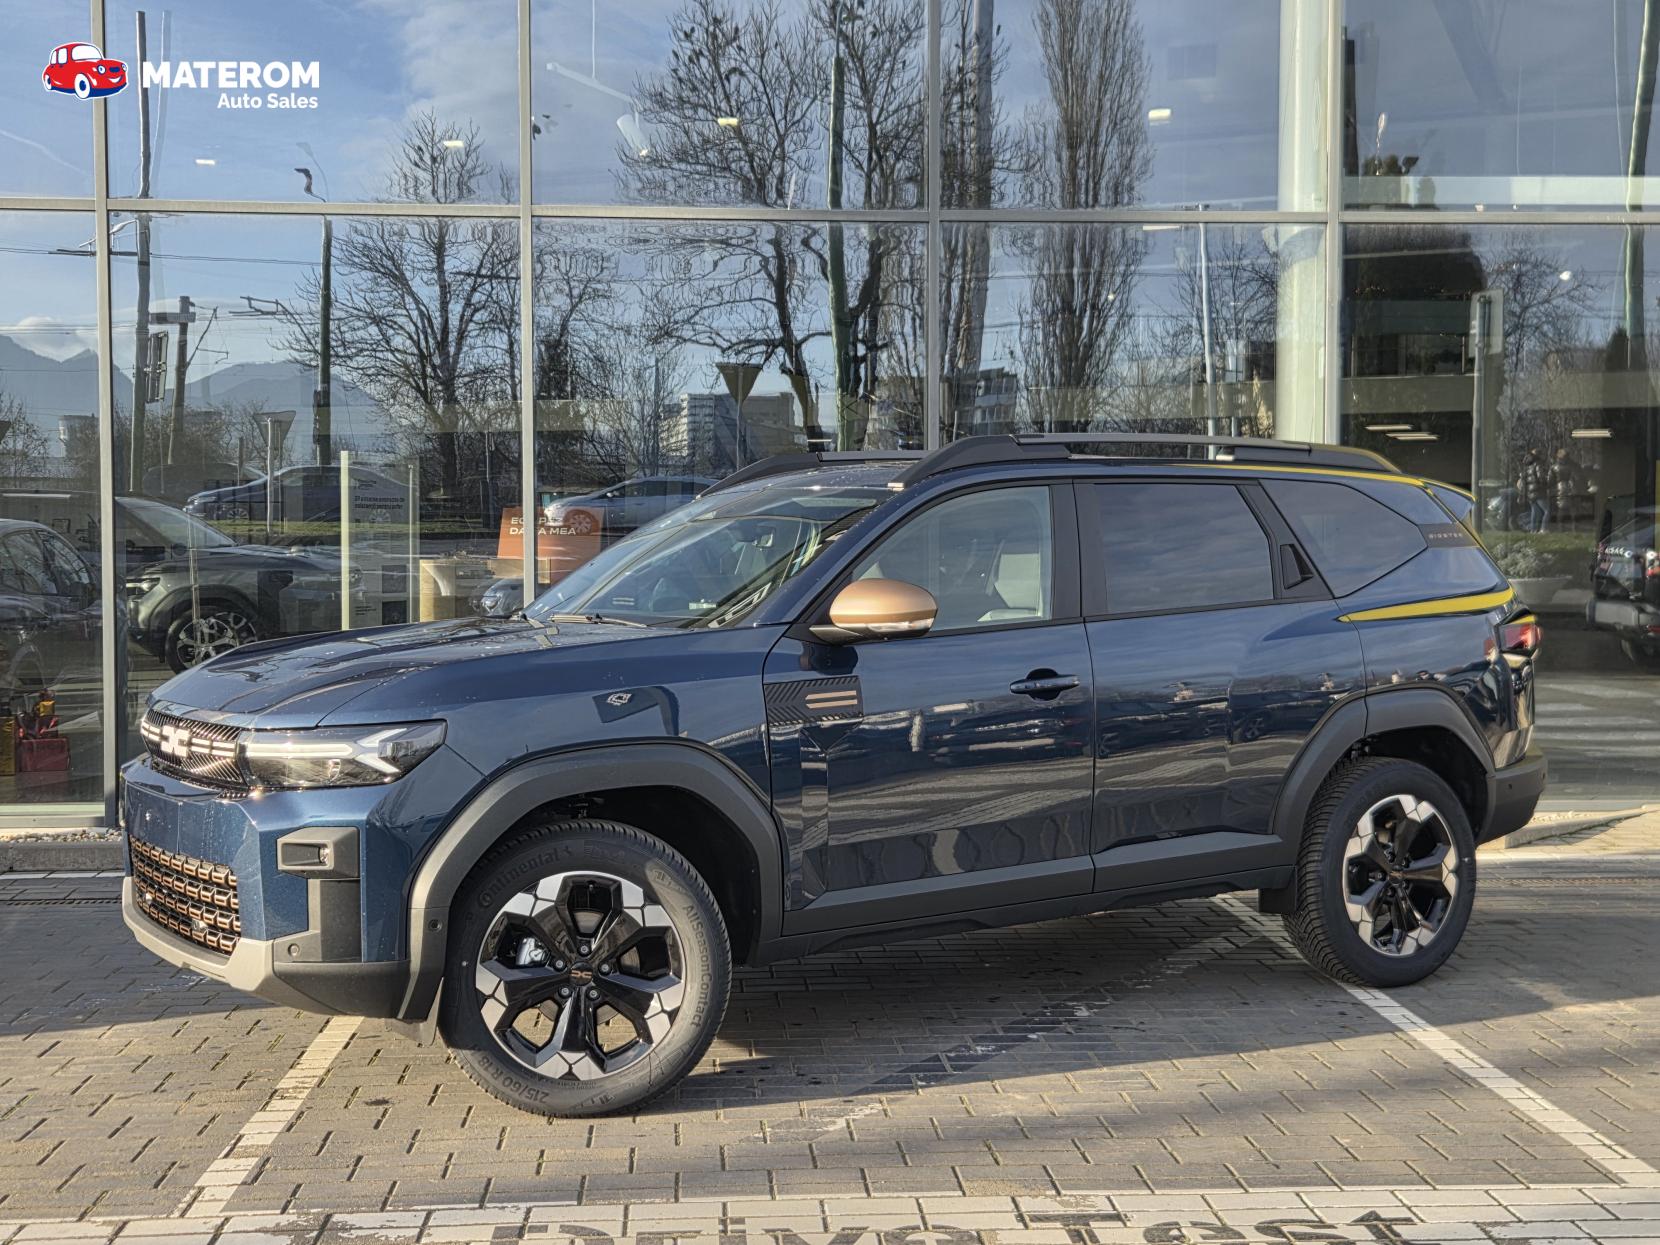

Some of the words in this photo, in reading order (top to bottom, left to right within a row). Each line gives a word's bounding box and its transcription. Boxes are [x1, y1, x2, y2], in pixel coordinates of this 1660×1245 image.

[509, 527, 547, 535] DAA
[549, 527, 576, 535] MEA
[501, 1077, 550, 1104] 215/60
